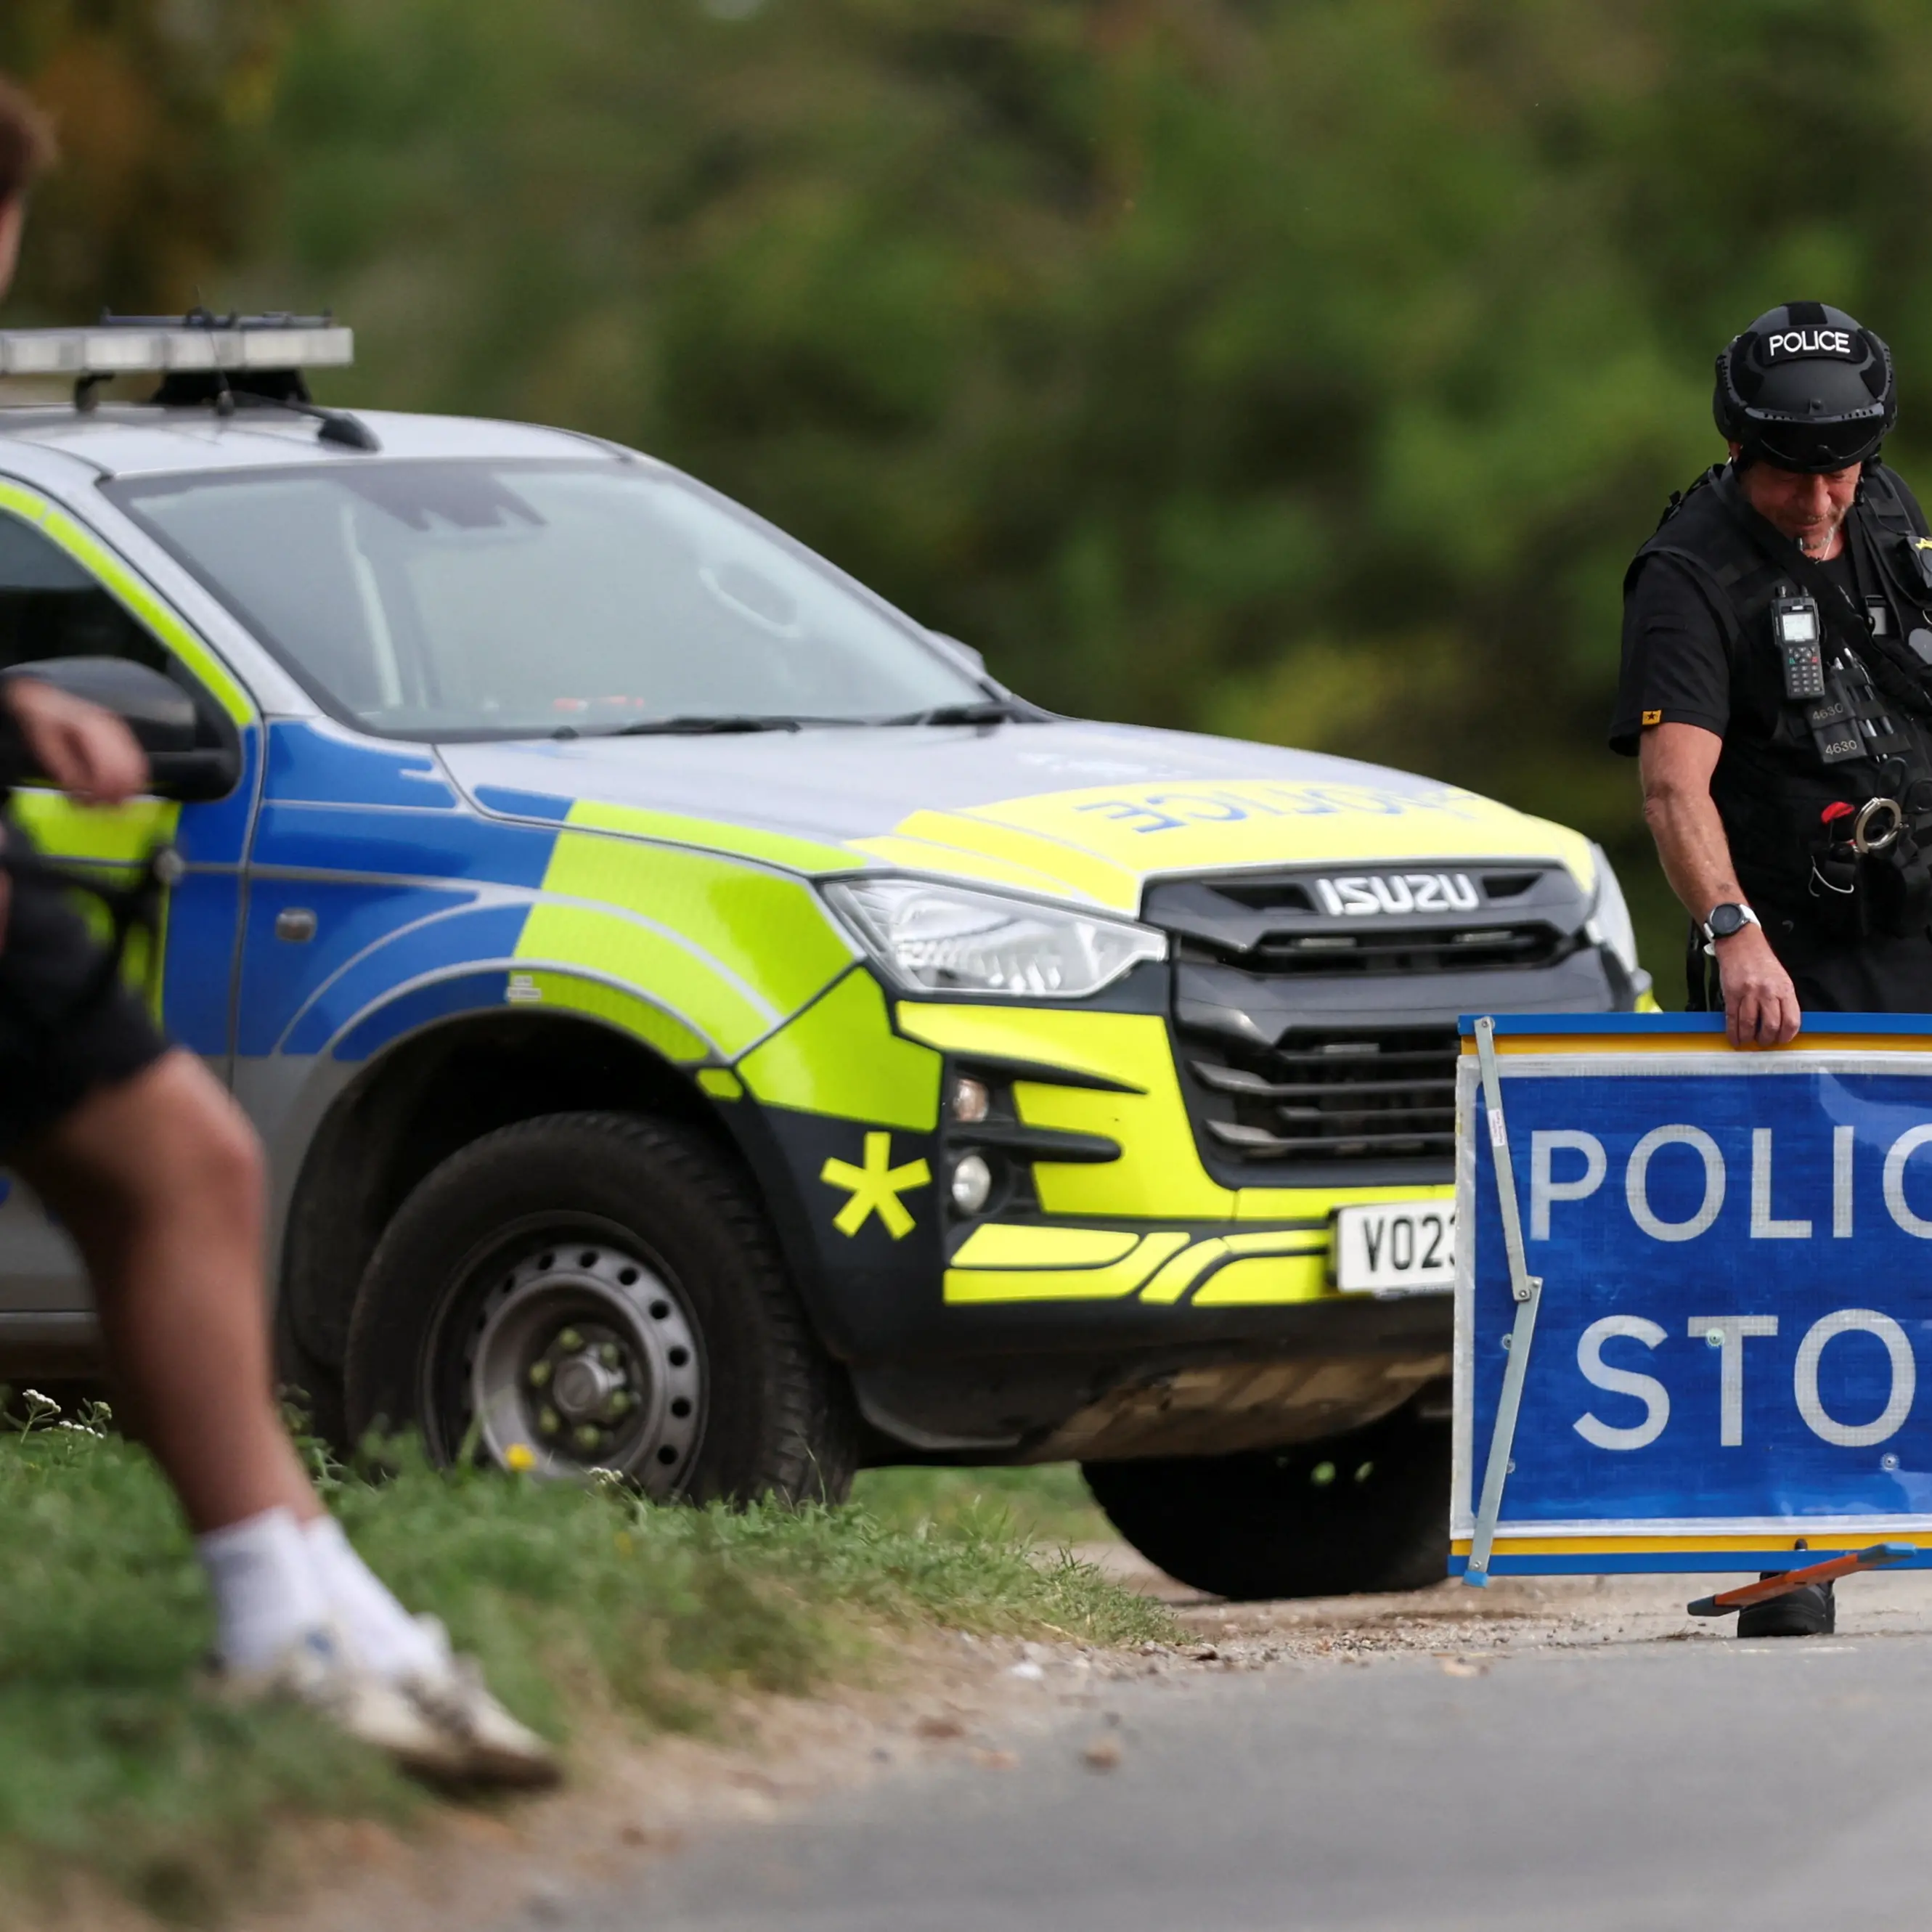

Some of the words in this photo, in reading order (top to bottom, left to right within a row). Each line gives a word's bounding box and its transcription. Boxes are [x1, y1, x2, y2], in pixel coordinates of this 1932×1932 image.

[1769, 330, 1851, 356] POLICE
[1812, 703, 1844, 720] 4630
[1825, 740, 1857, 755] 4630
[1315, 873, 1480, 917] ISUZU
